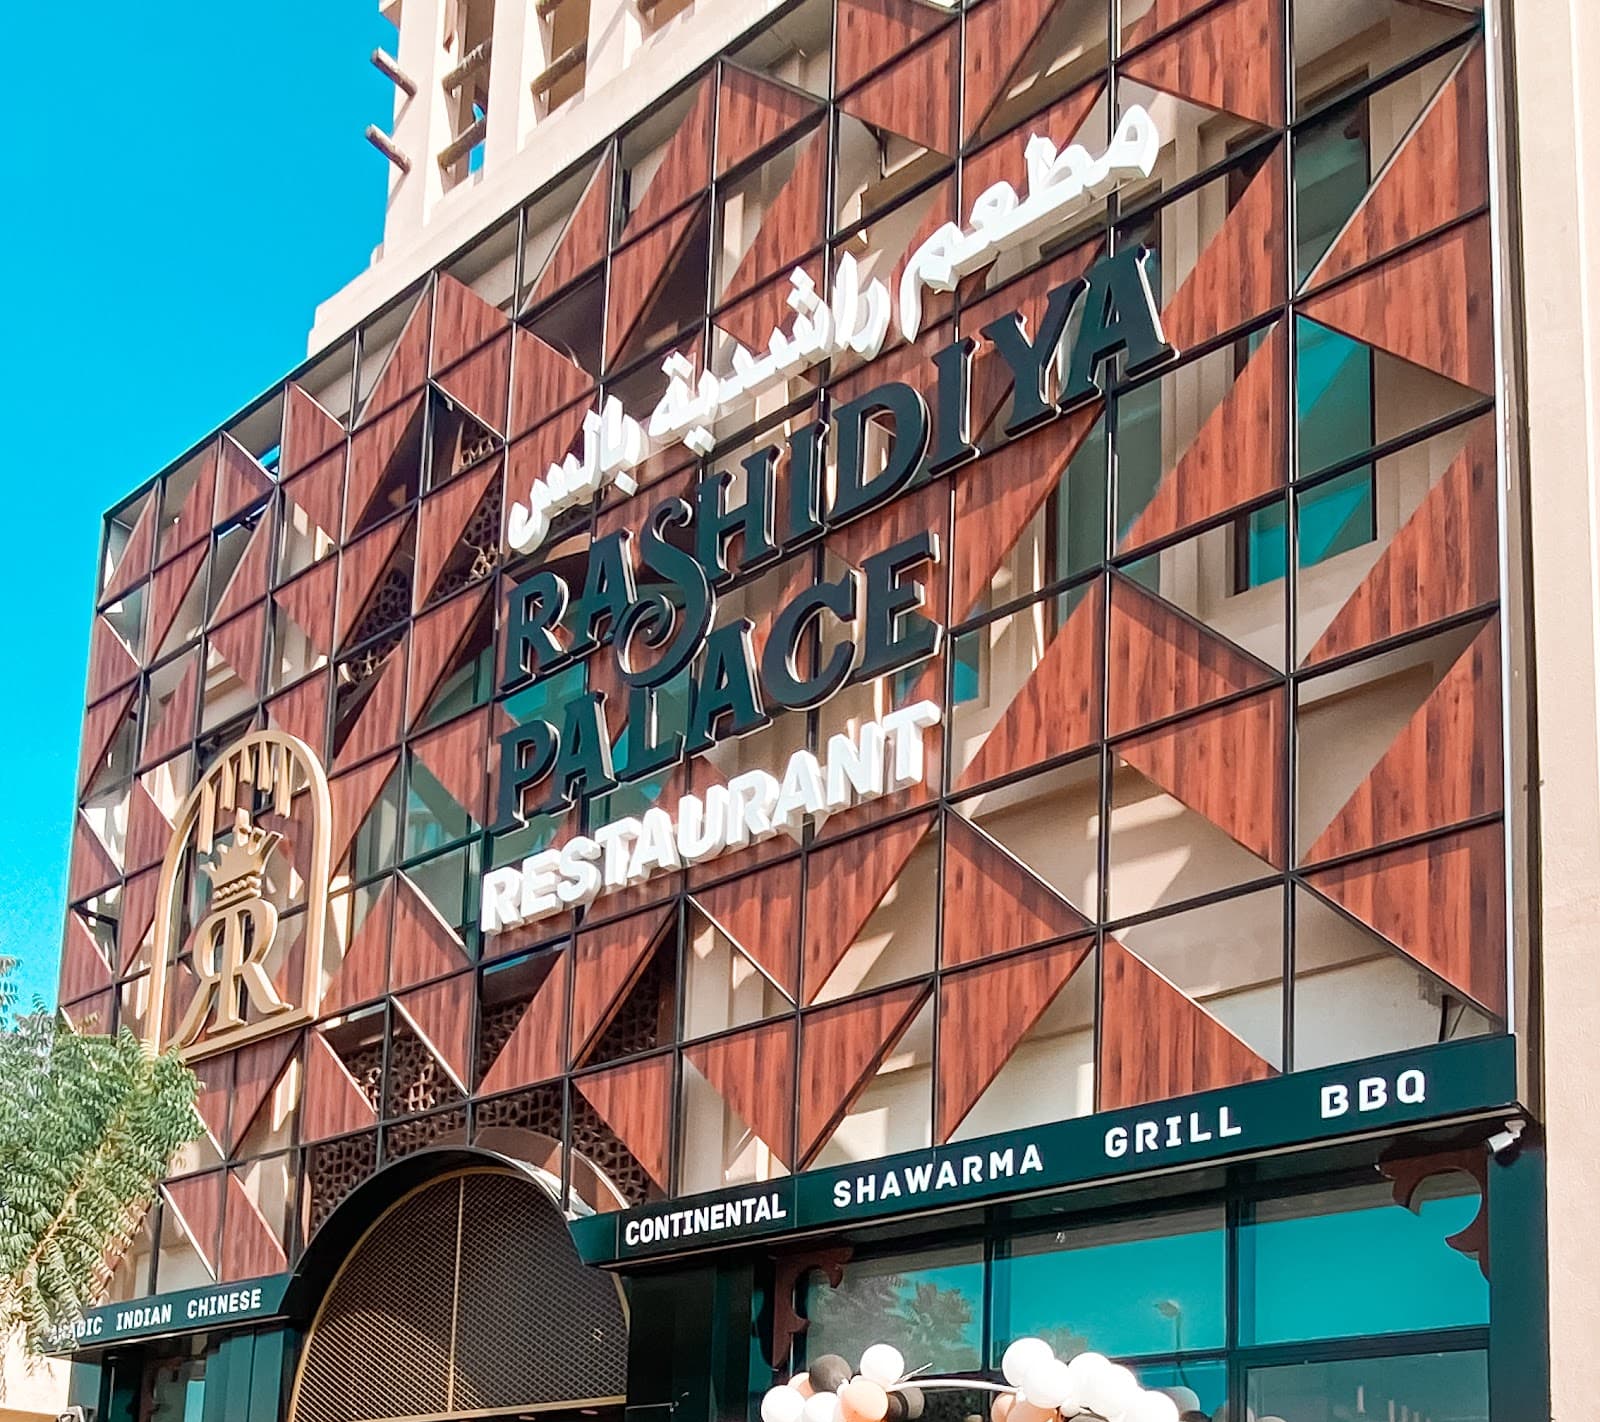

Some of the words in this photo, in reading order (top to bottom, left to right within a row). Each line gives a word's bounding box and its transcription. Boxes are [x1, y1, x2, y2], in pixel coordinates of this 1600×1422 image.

[899, 104, 1160, 345] مطعم
[499, 244, 1181, 694] RASHIDIYA
[488, 532, 944, 837] PALACE
[480, 698, 941, 934] RESTAURANT
[624, 1194, 787, 1247] CONTINENTAL
[833, 1142, 1043, 1208] SHAWARMA
[1104, 1105, 1242, 1159] GRILL
[1320, 1068, 1428, 1120] BBQ
[116, 1304, 172, 1331] INDIAN
[187, 1288, 262, 1319] CHINESE
